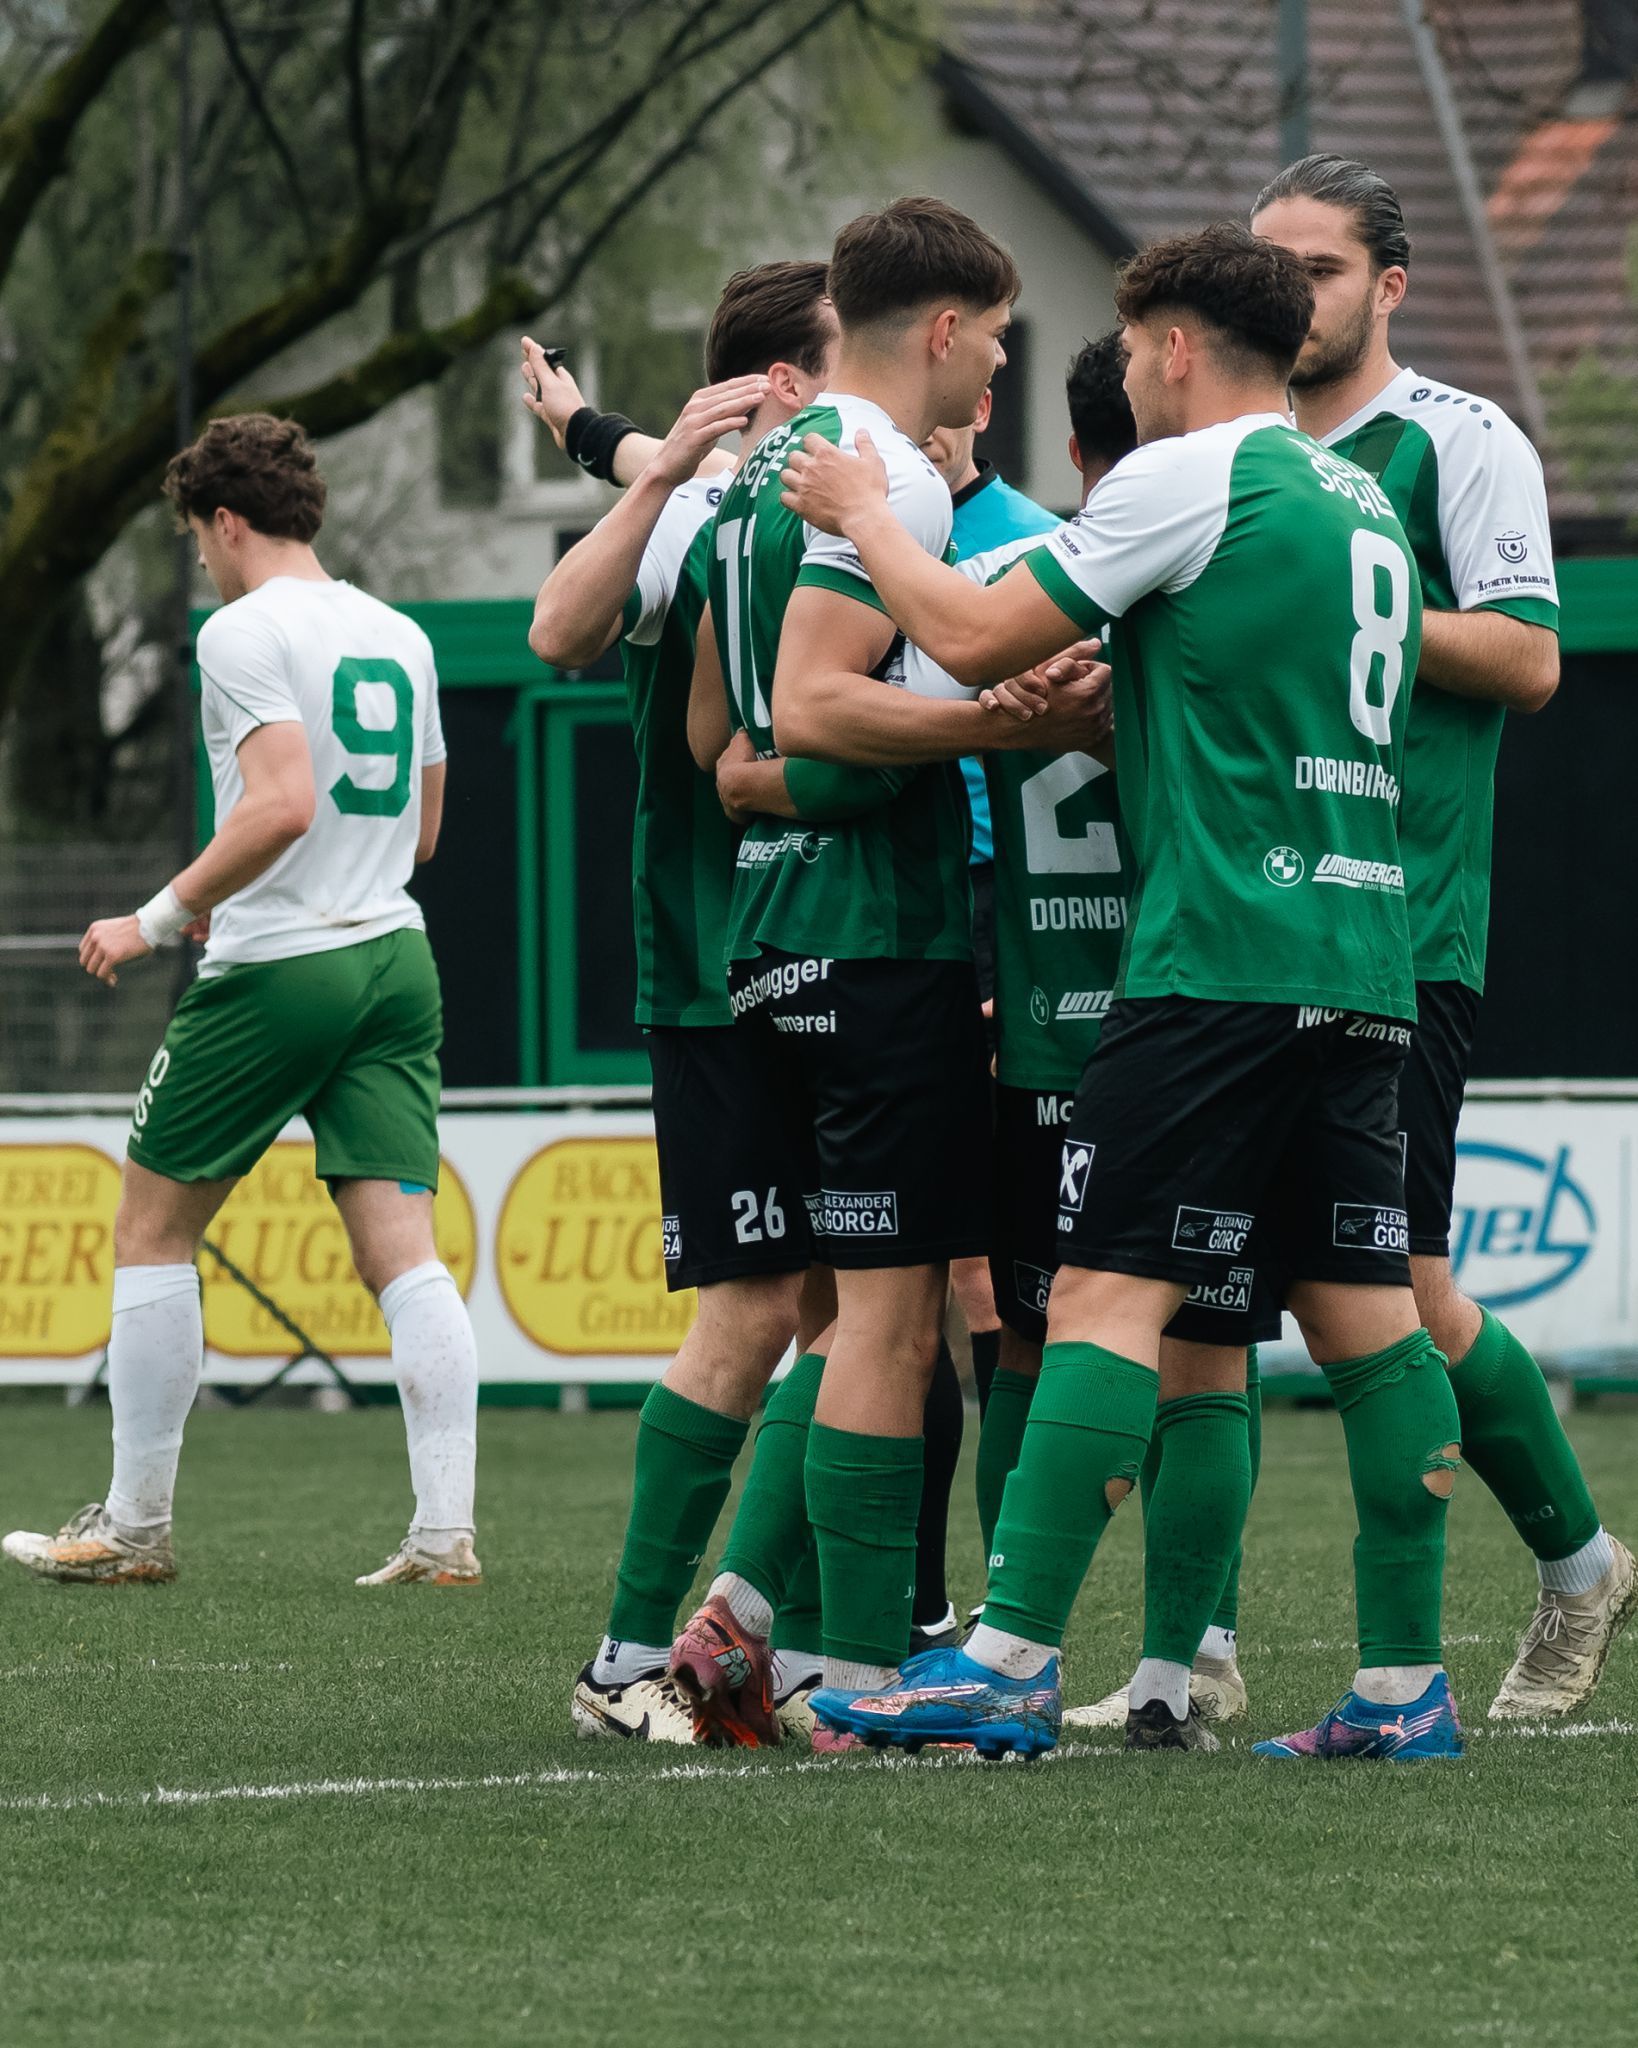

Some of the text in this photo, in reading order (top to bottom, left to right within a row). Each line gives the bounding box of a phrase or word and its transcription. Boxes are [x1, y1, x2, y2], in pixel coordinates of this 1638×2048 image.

[716, 512, 773, 730] 11
[1350, 528, 1409, 746] 8
[329, 656, 415, 818] 9
[1021, 751, 1122, 874] 2
[731, 1187, 786, 1243] 26
[824, 1195, 892, 1209] ALEXANDER
[825, 1209, 894, 1232] GORGA
